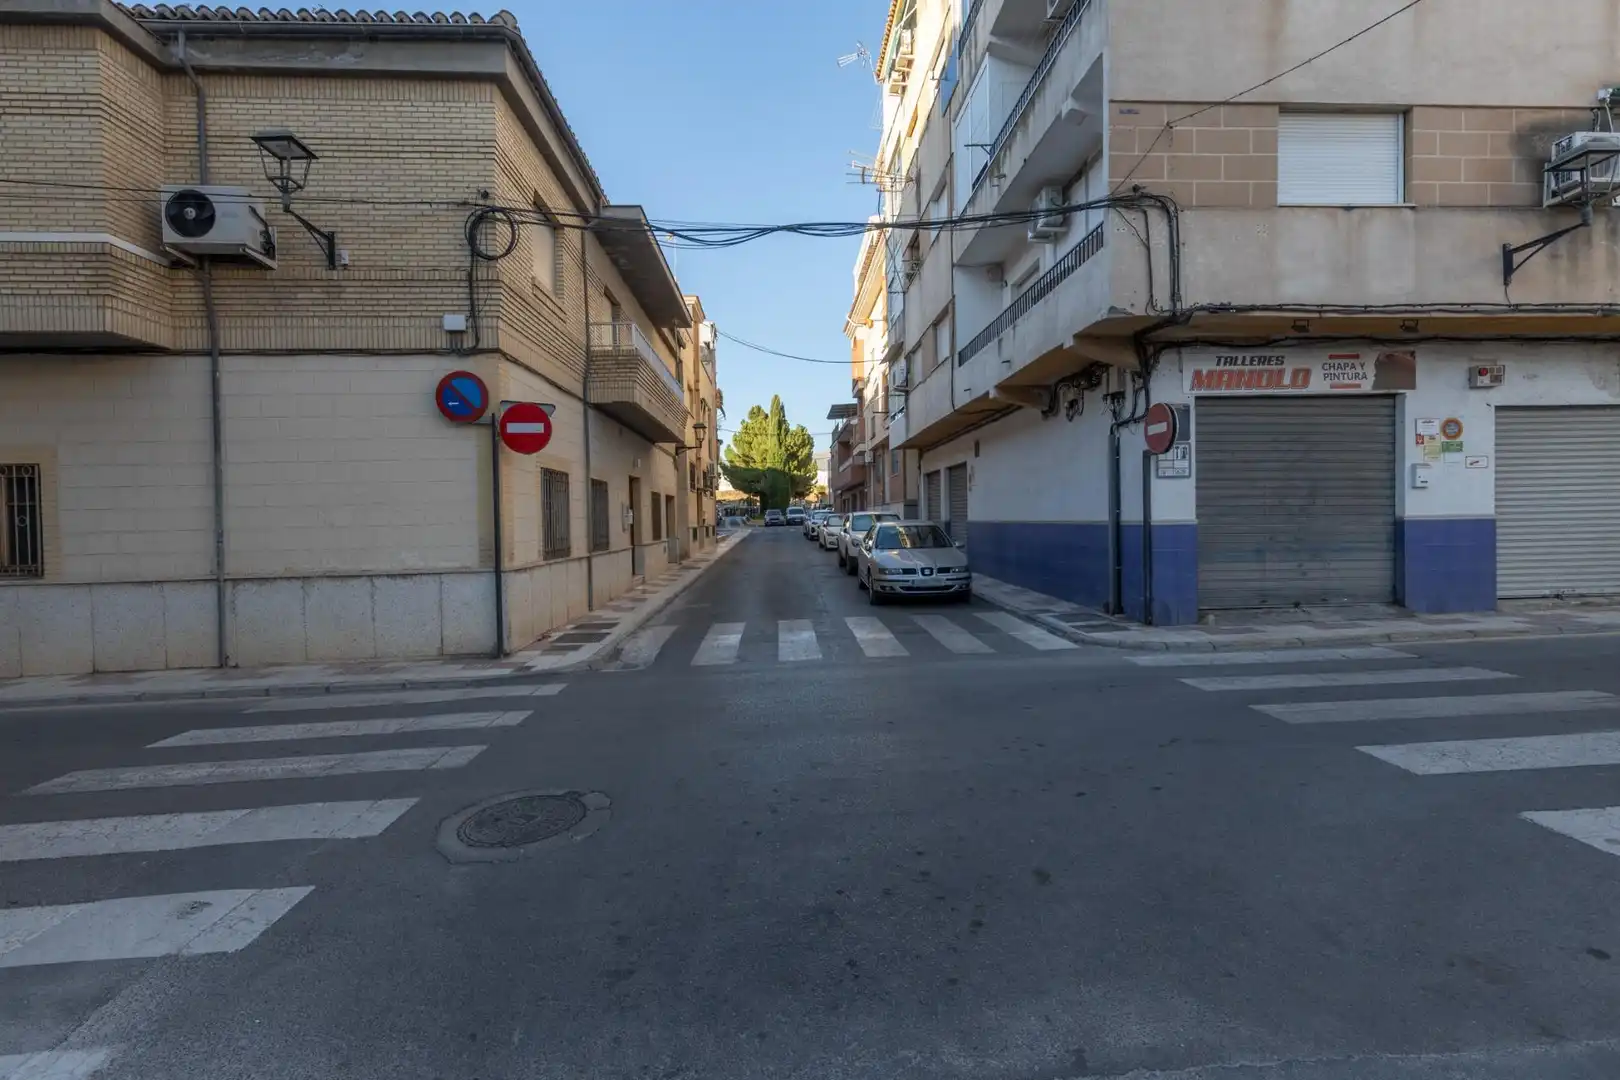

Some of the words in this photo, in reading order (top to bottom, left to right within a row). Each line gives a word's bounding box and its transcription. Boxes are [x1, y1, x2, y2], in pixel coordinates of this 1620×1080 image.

[1215, 355, 1285, 366] TALLERES
[1322, 362, 1356, 371] CHAPA
[1358, 362, 1366, 371] Y
[1189, 367, 1312, 391] MANOLO
[1323, 371, 1368, 381] PINTURA
